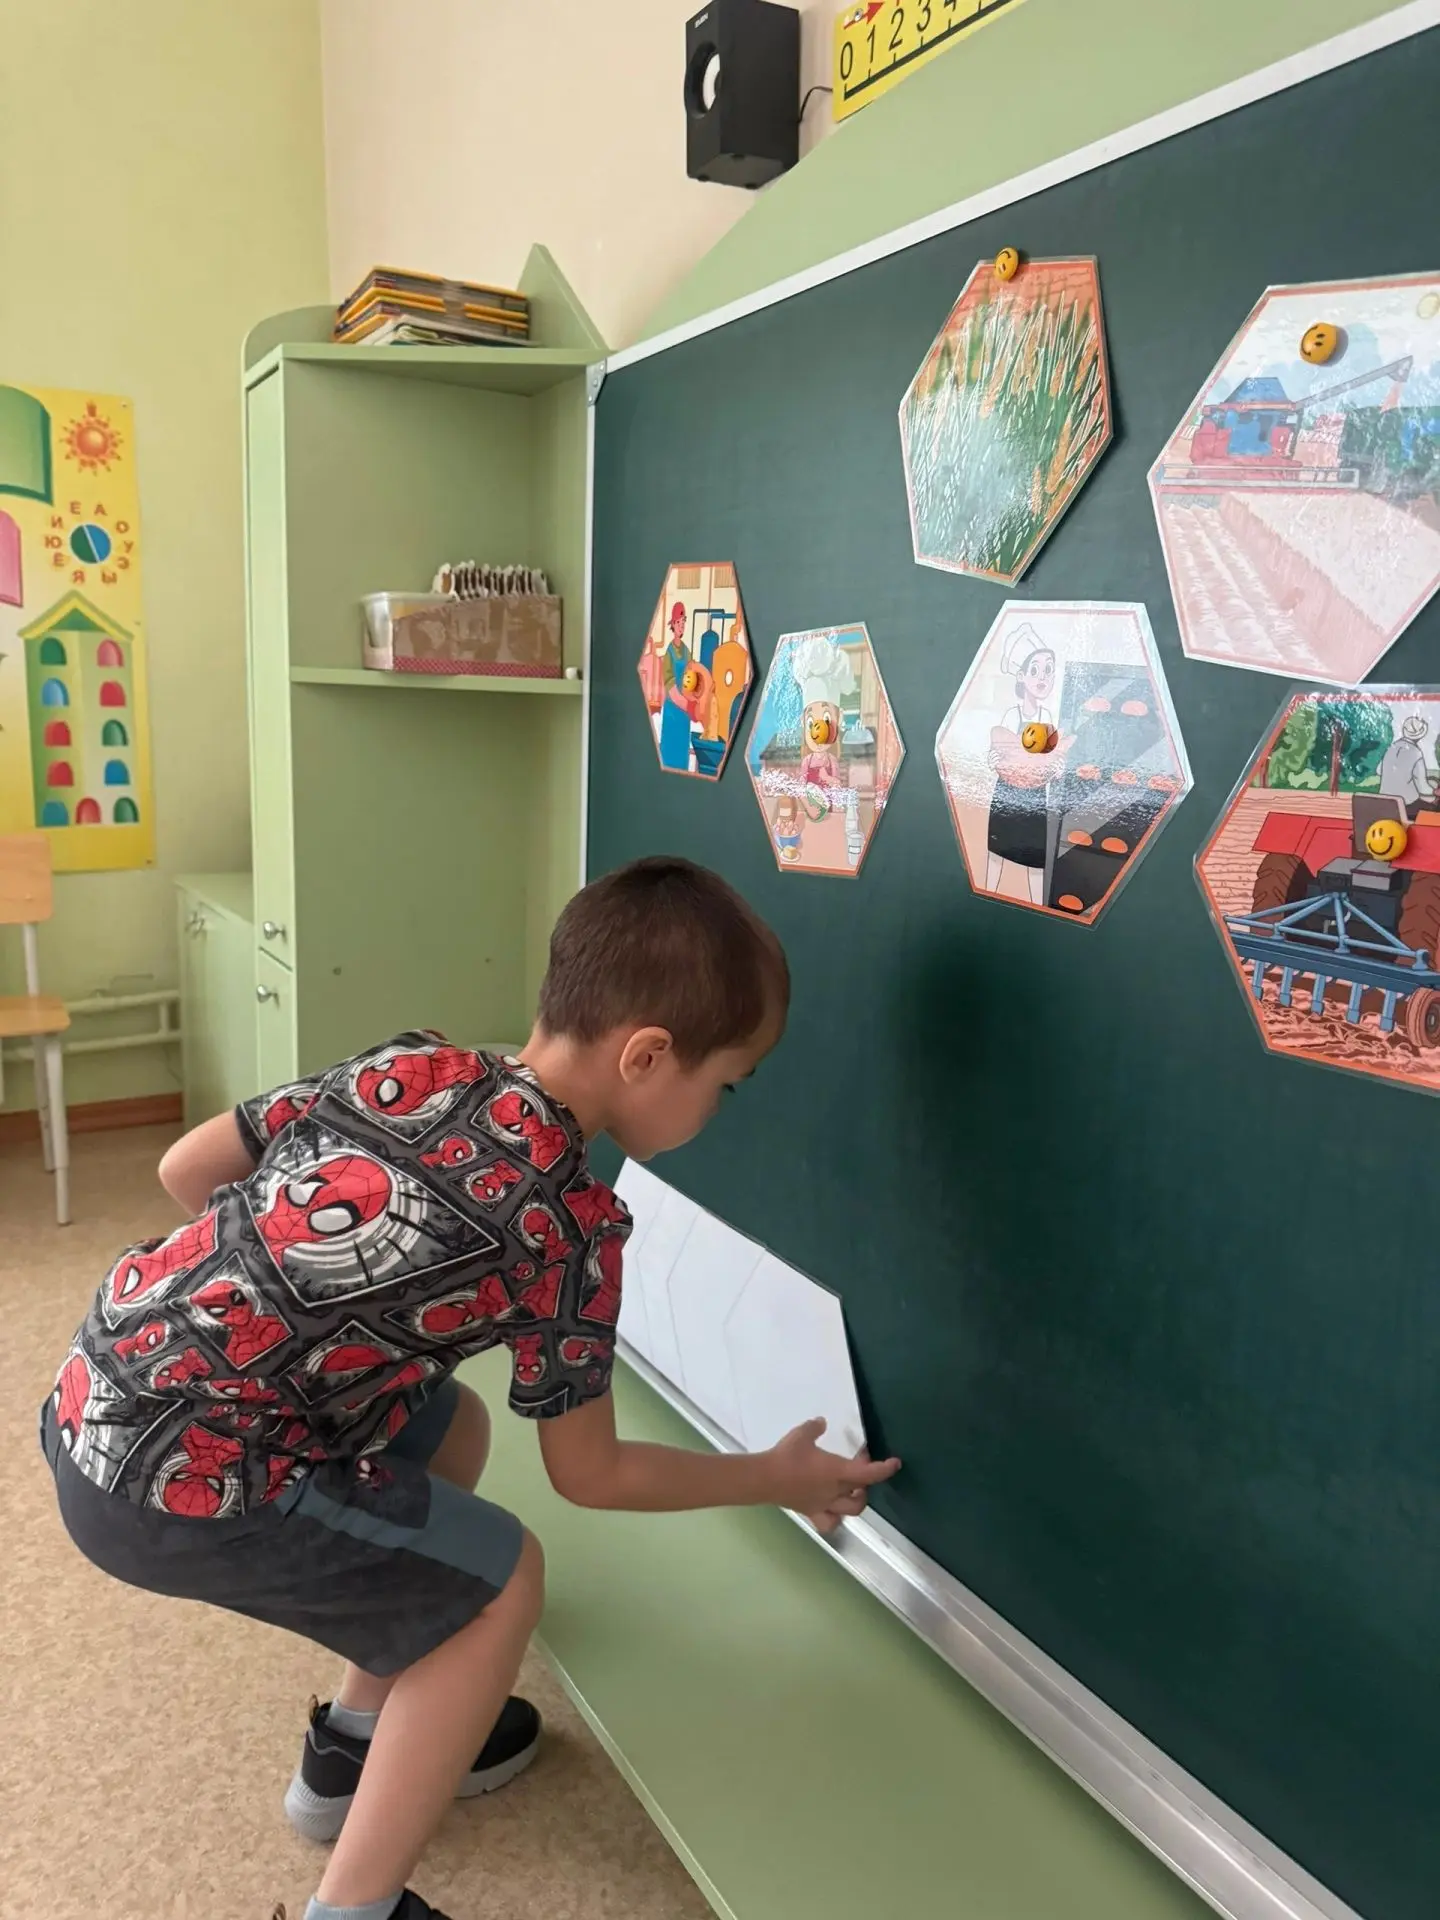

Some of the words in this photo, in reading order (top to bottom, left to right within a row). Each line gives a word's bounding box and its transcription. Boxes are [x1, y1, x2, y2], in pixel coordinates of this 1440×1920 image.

[840, 41, 853, 80] 0
[867, 24, 876, 64] 1
[888, 8, 904, 51] 2
[916, 0, 932, 32] 3
[94, 502, 107, 516] А
[51, 516, 63, 529] И
[116, 520, 130, 534] О
[44, 535, 63, 549] Ю
